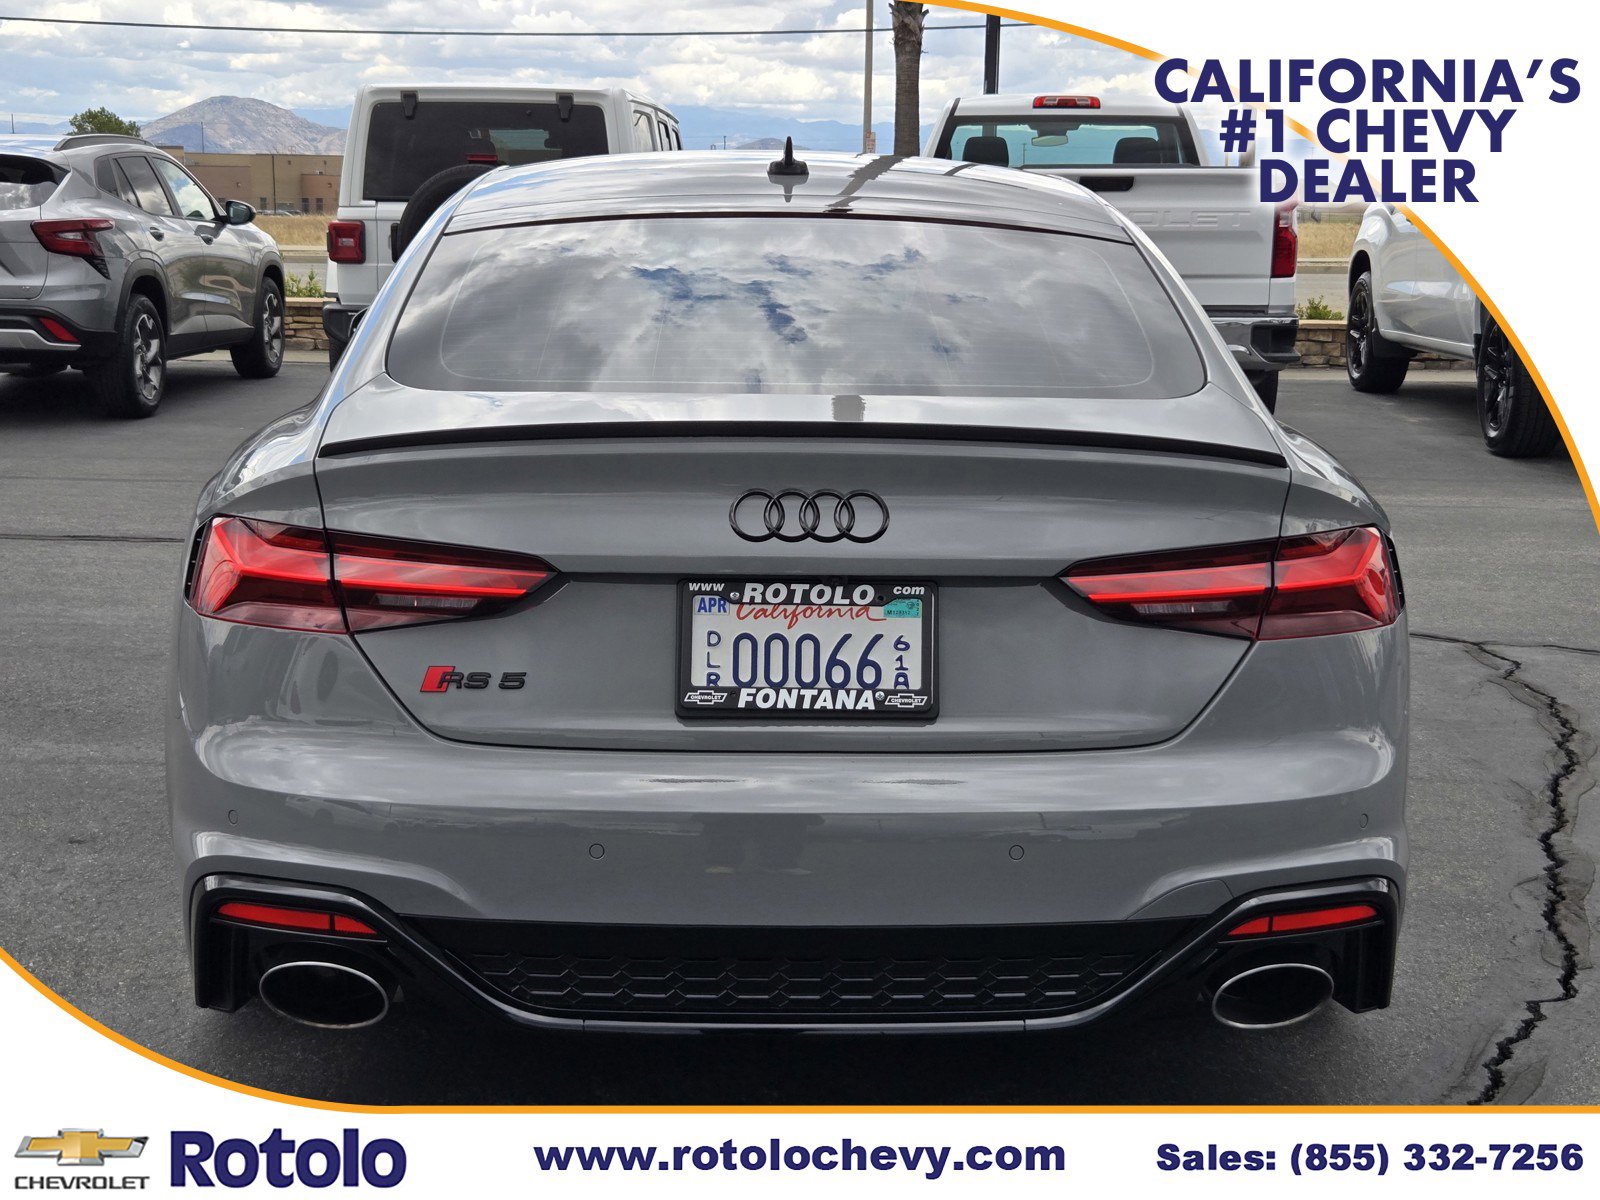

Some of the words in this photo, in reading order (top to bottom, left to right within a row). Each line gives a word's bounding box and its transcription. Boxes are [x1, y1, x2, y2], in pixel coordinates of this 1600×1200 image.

[697, 596, 728, 614] APR
[742, 582, 875, 606] ROTOLO
[893, 585, 925, 596] com
[736, 602, 887, 630] California
[732, 632, 884, 690] 00066
[437, 671, 492, 690] RS
[498, 671, 528, 690] 5
[737, 687, 876, 710] FONTANA
